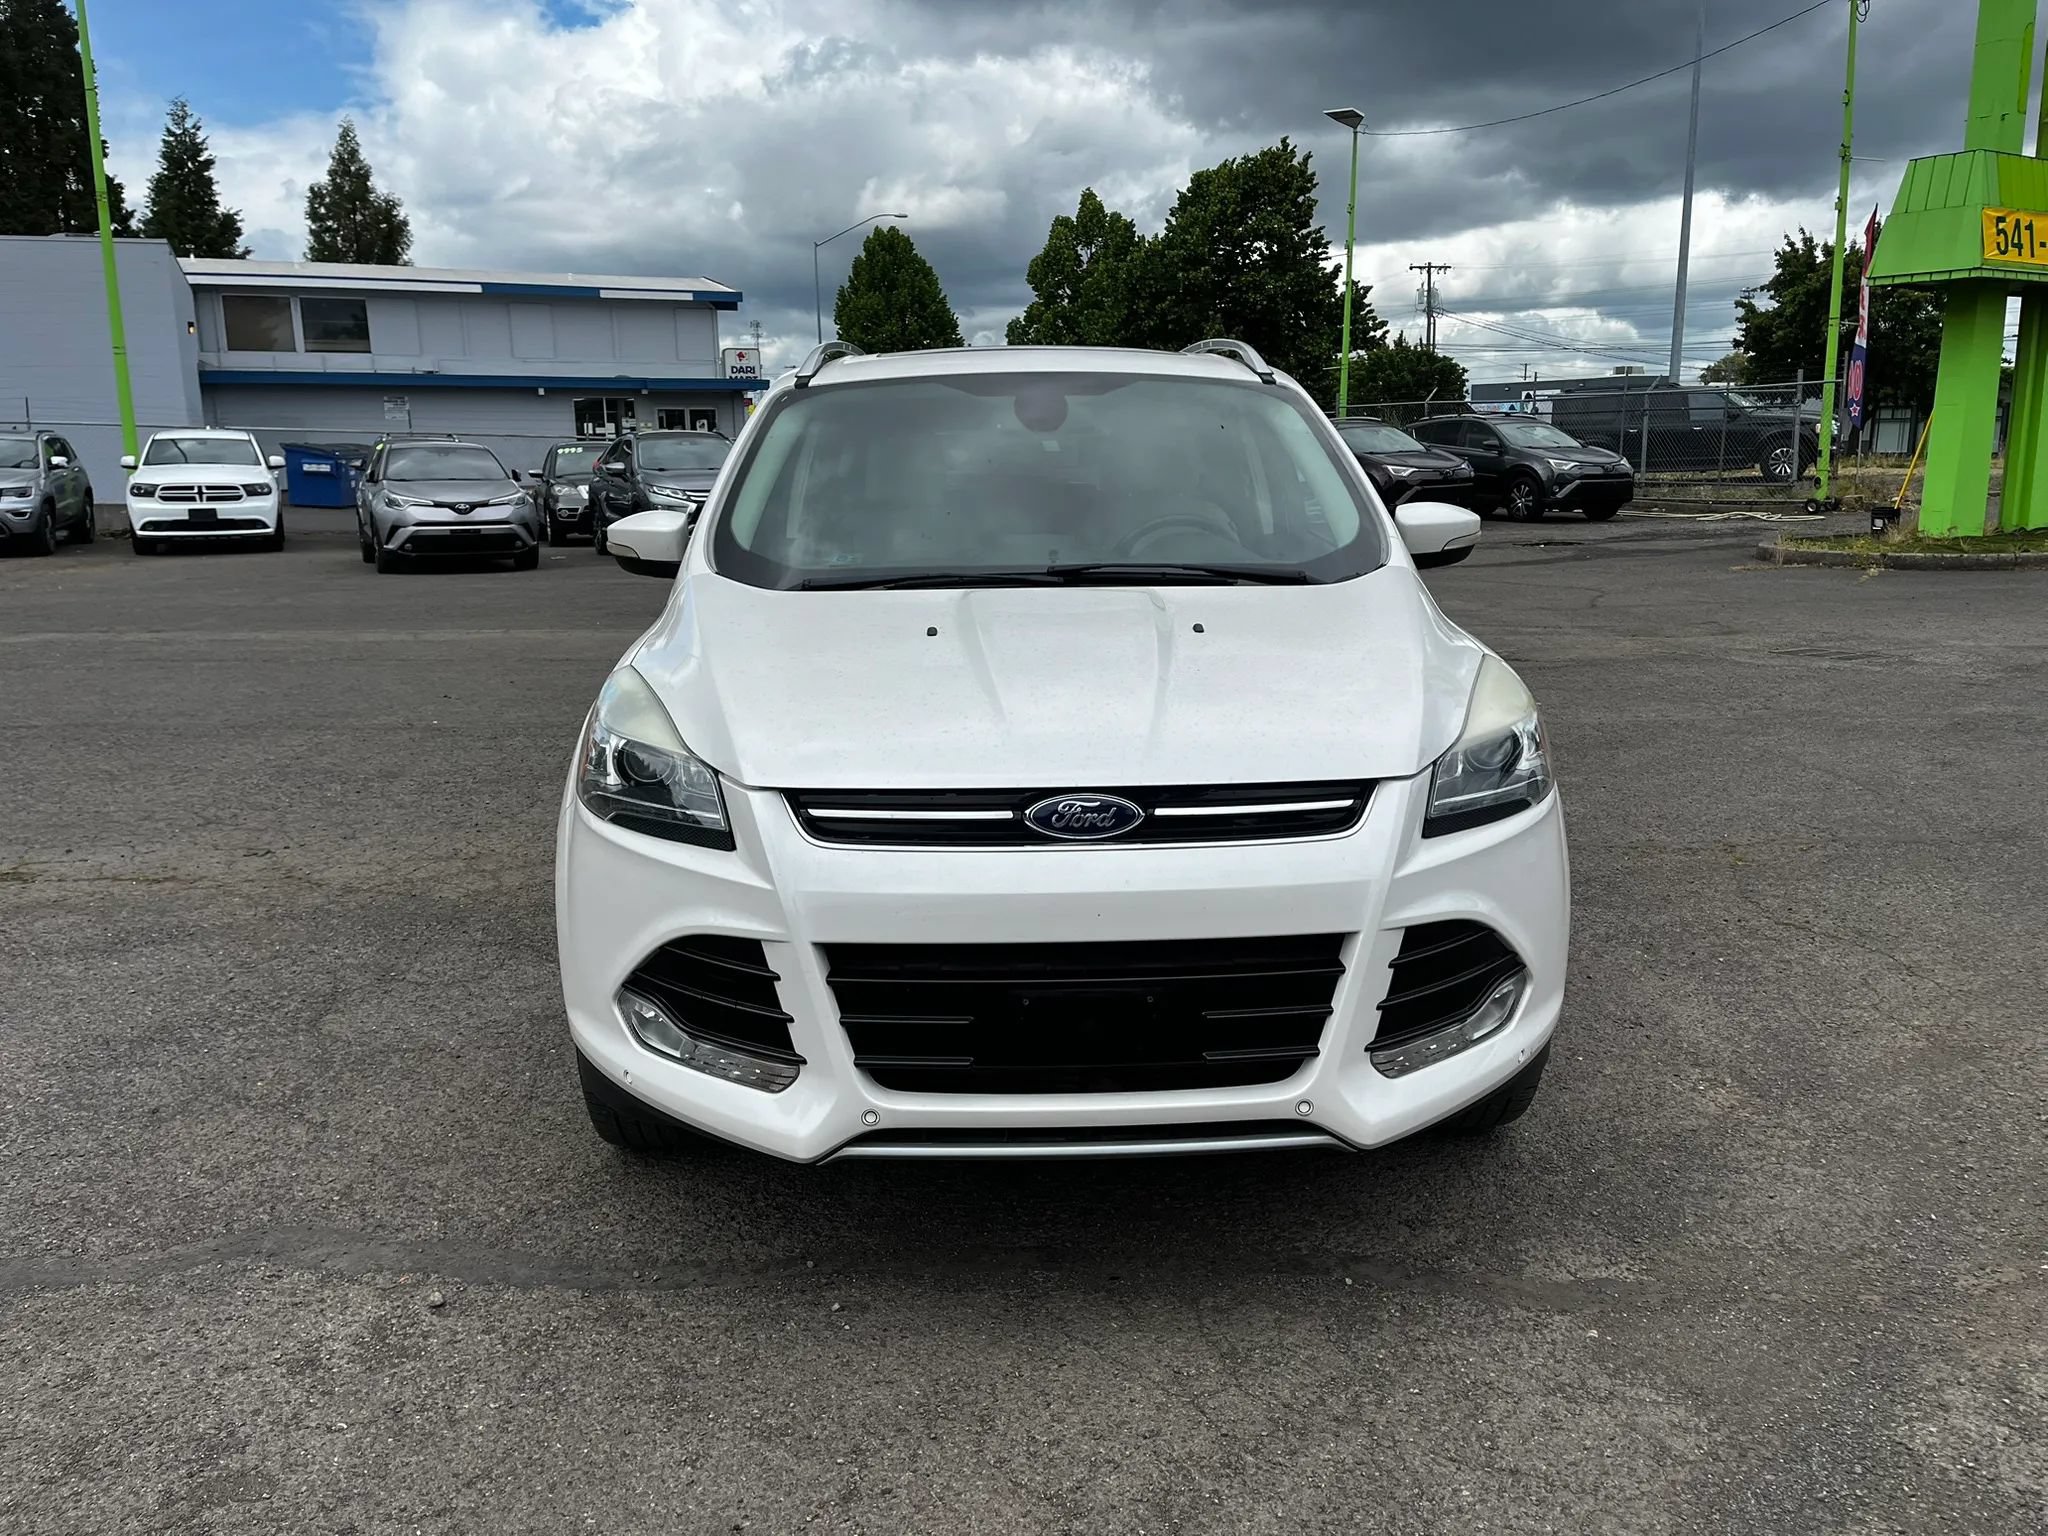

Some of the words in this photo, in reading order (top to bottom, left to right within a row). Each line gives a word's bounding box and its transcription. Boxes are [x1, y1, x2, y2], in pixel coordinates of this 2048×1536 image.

[1995, 216, 2047, 258] 541-
[731, 366, 755, 374] DARI
[1051, 801, 1117, 828] Ford
